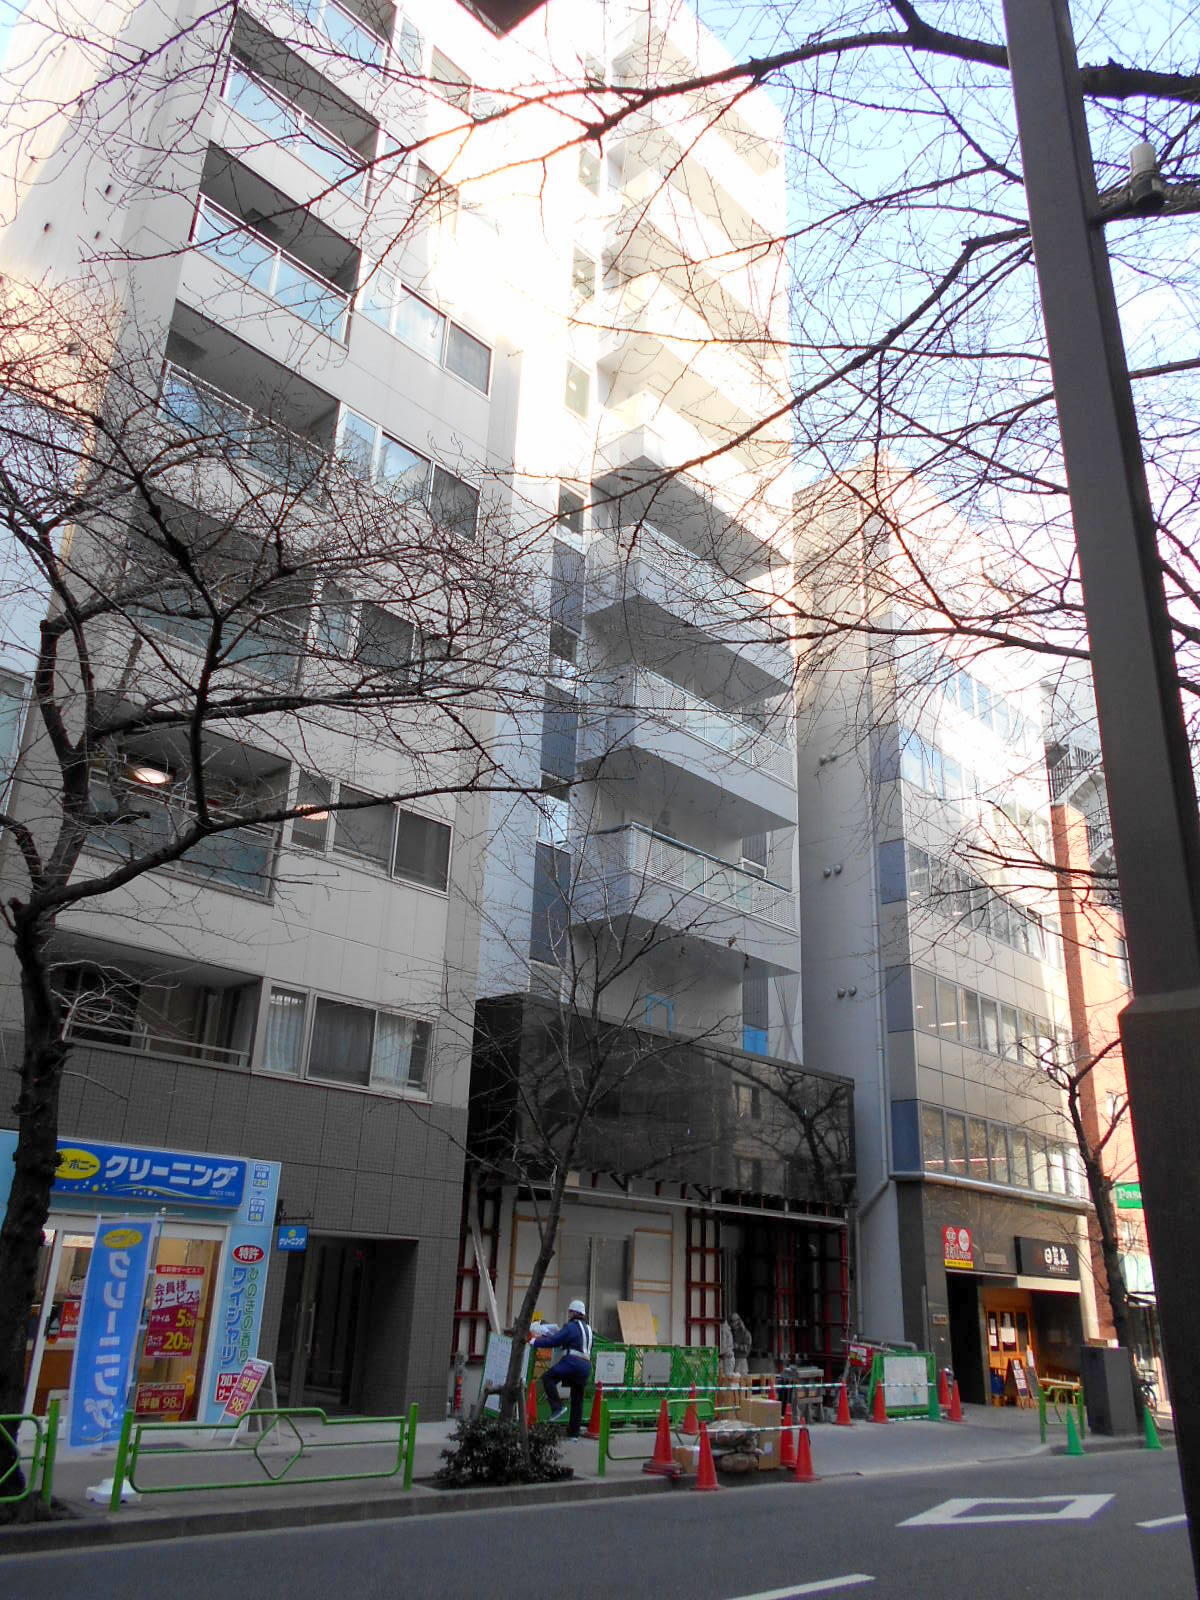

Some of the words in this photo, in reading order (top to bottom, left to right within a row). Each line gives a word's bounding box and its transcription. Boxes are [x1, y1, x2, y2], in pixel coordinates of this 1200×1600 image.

[105, 1155, 238, 1189] クリーニング
[238, 1246, 260, 1261] 特許
[155, 1280, 188, 1297] 会員様
[222, 1266, 248, 1366] ワイシャツ
